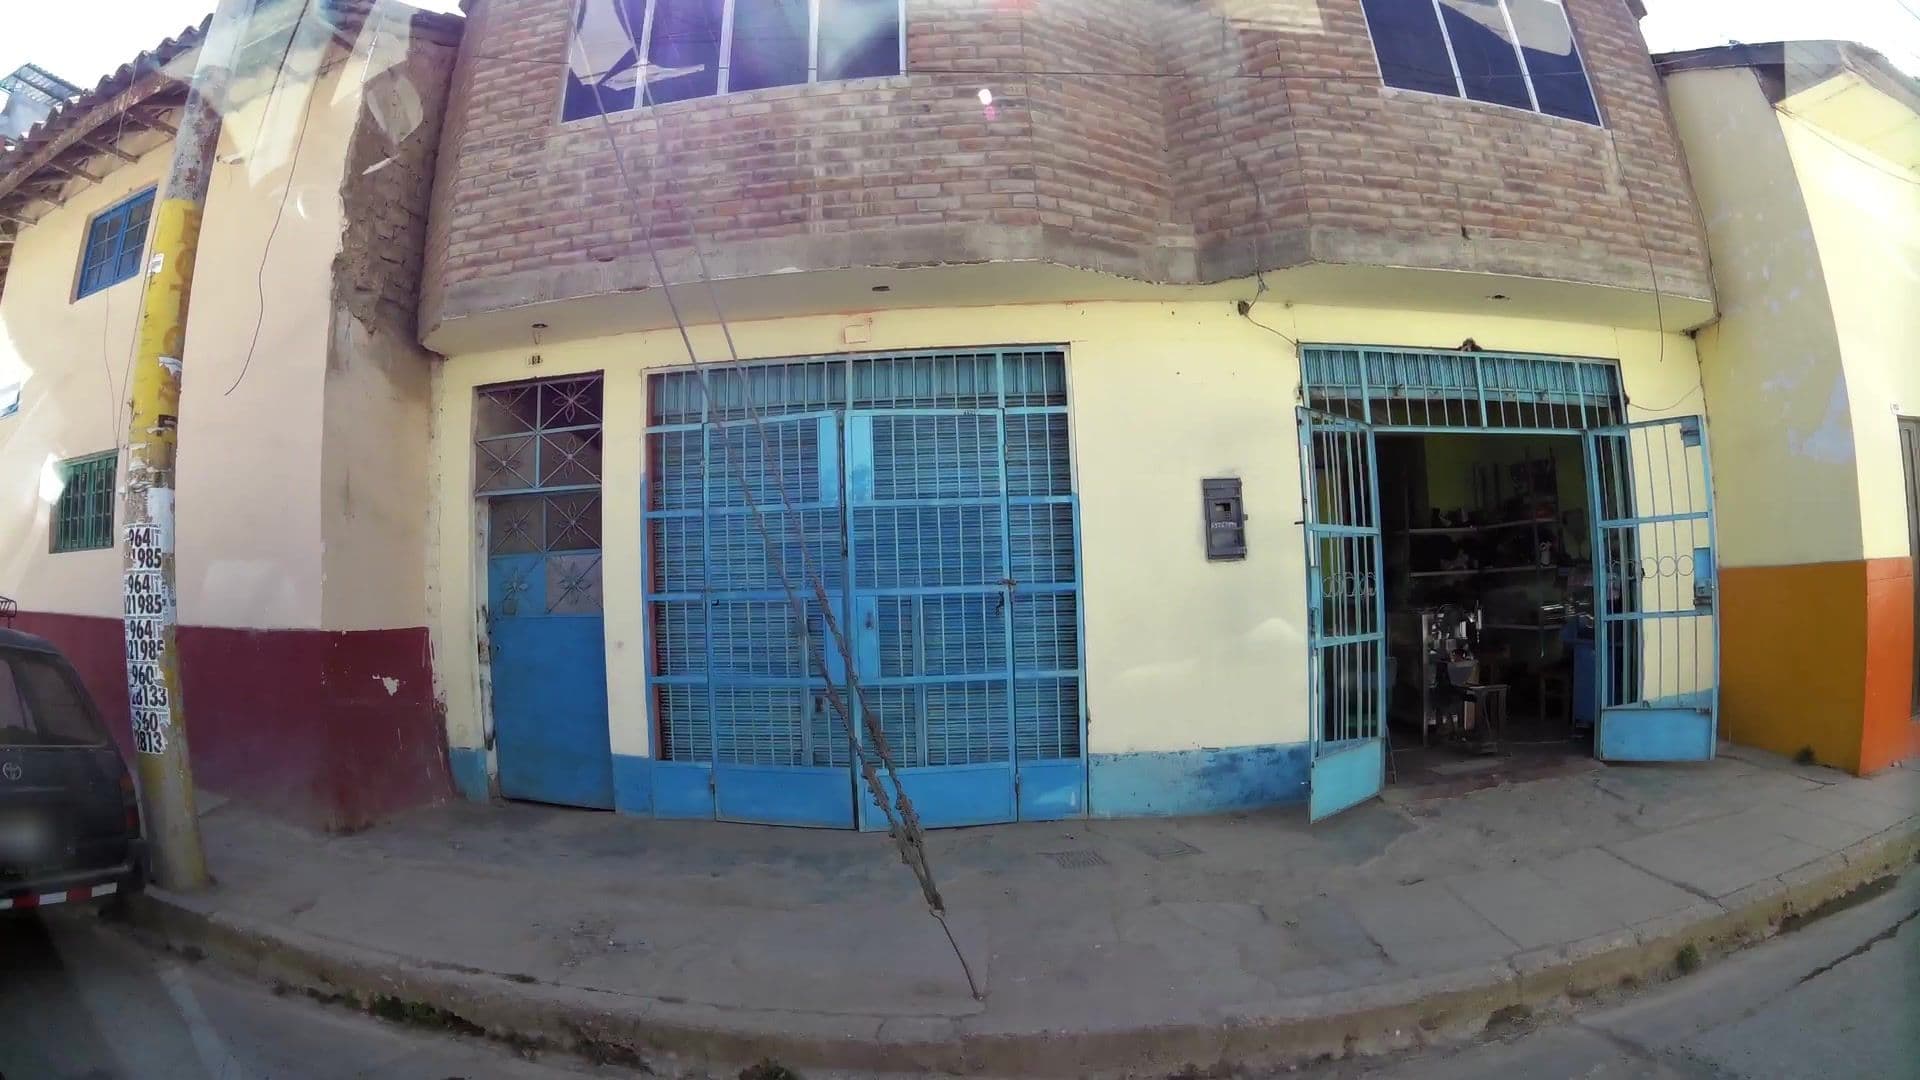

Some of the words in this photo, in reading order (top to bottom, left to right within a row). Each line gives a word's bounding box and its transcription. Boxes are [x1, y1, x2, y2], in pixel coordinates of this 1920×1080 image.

[128, 574, 150, 594] 964
[130, 620, 152, 639] 964
[132, 665, 154, 685] 960
